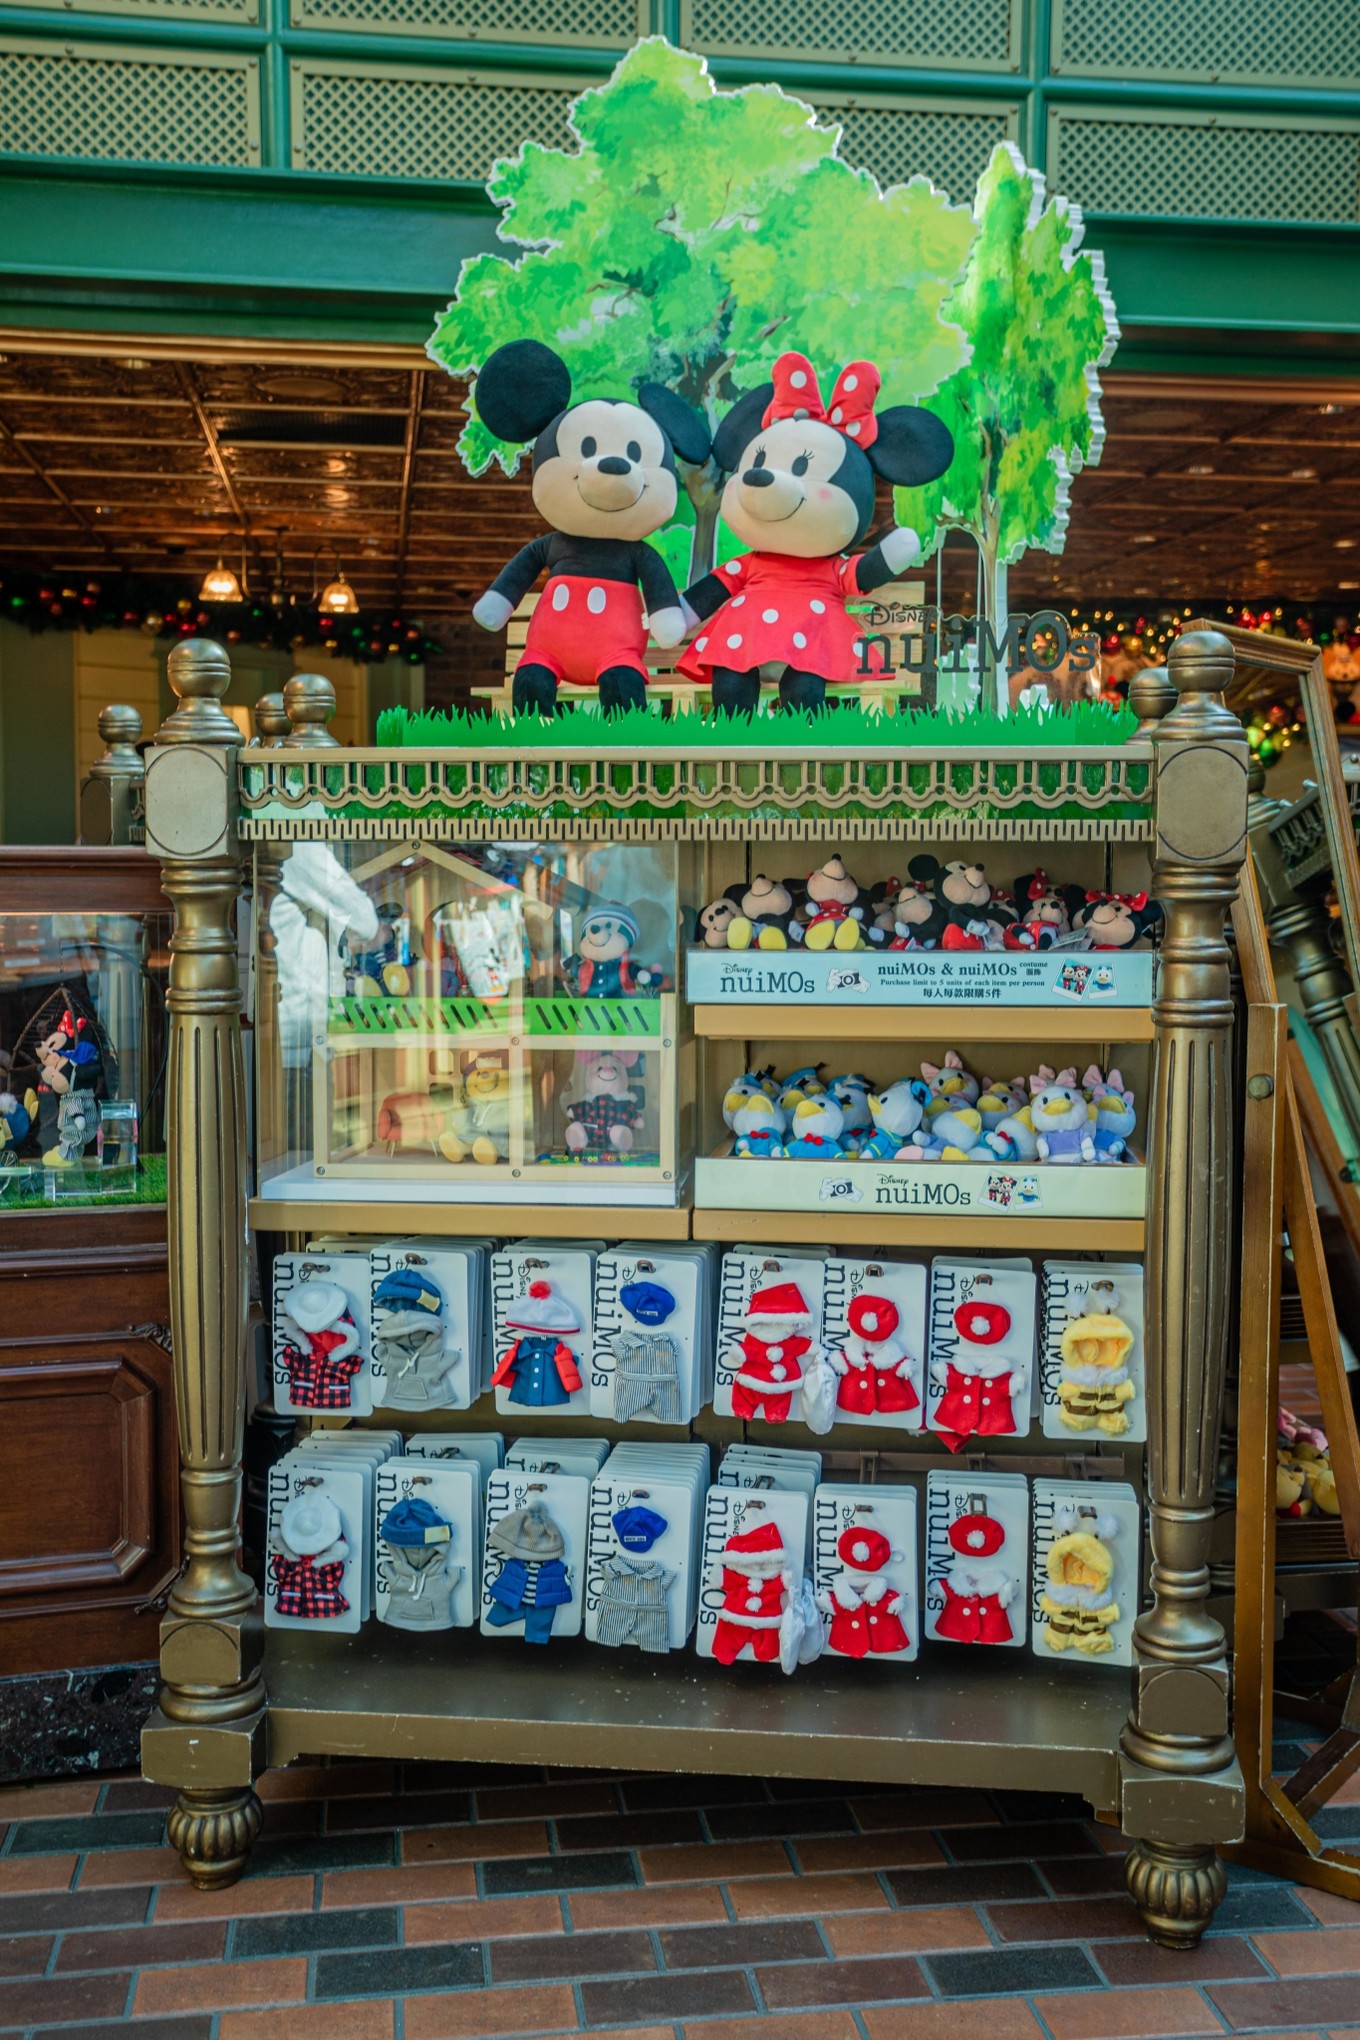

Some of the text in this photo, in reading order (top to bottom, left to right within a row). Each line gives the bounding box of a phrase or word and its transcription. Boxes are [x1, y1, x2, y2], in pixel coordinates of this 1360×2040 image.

[857, 614, 1097, 674] nuiMOs
[721, 962, 753, 976] Disney
[878, 962, 1017, 976] nuiMOs & nuiMOs
[720, 971, 815, 993] nuiMOs
[877, 1173, 909, 1186] Disney
[875, 1183, 971, 1205] nuiMOs
